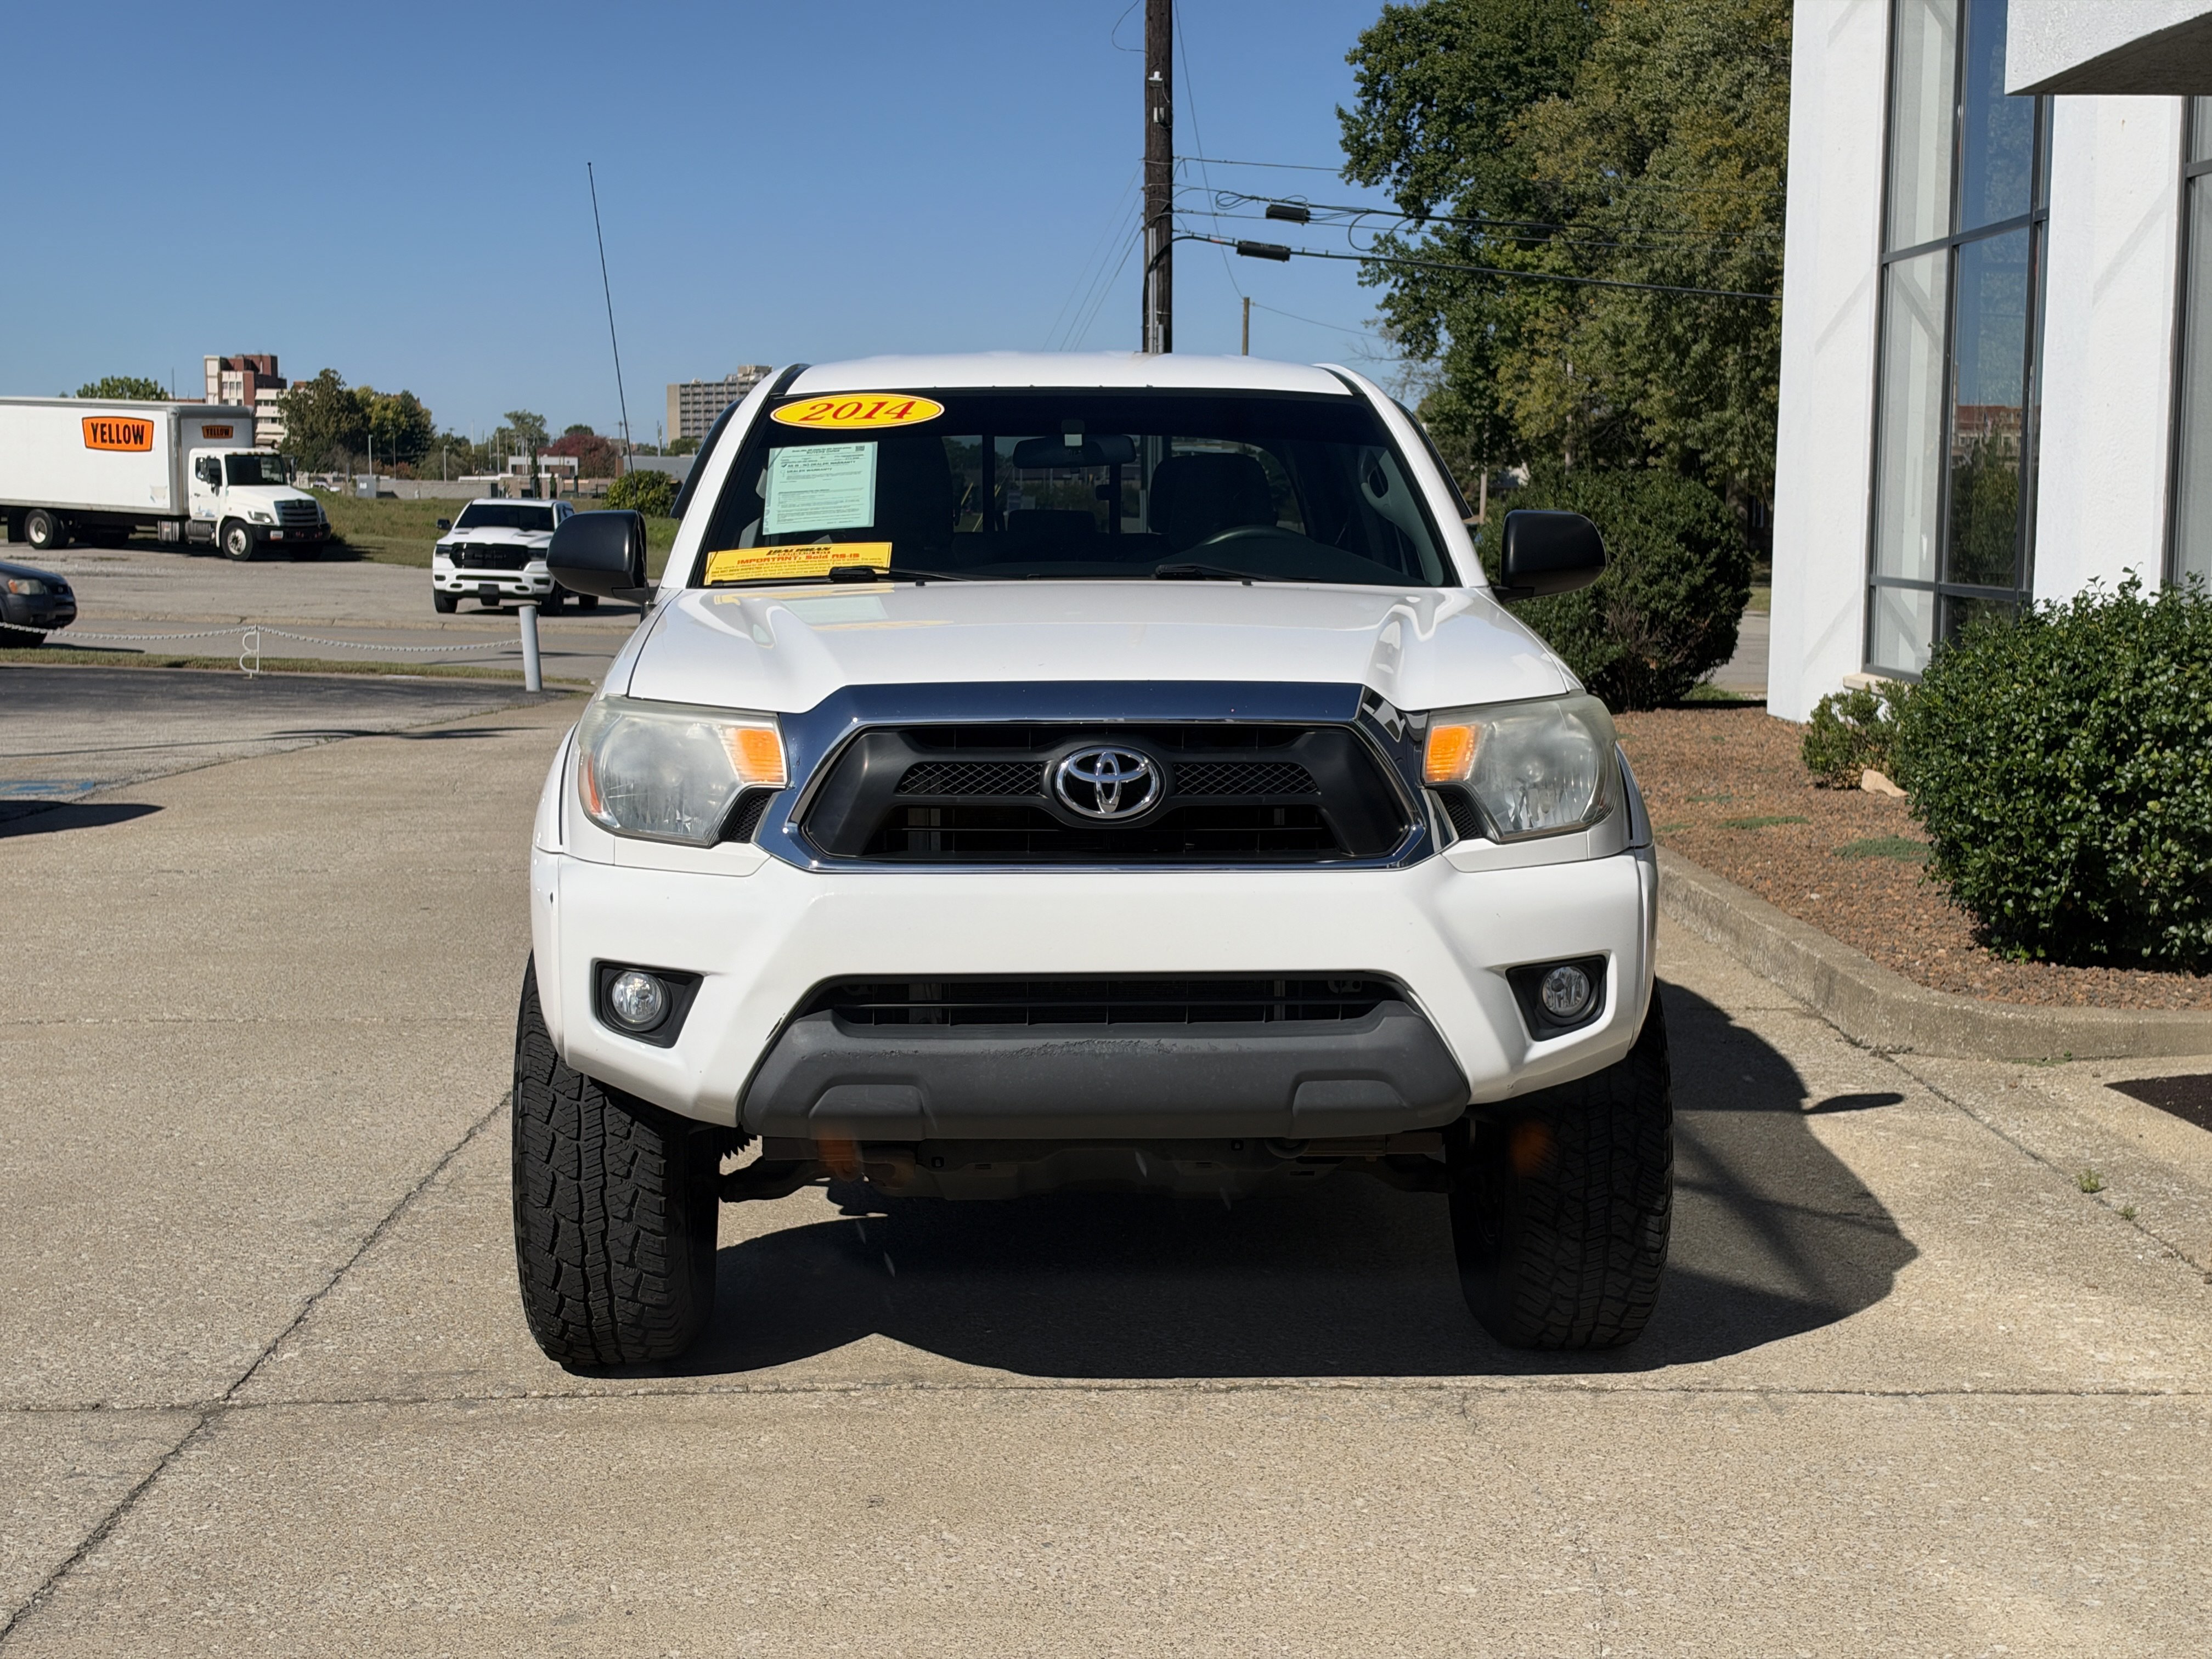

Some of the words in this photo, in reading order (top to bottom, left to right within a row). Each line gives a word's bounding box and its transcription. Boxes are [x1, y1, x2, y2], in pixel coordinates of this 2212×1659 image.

[798, 401, 917, 422] 2014
[91, 422, 145, 445] YELLOW
[206, 427, 229, 437] YELLOW
